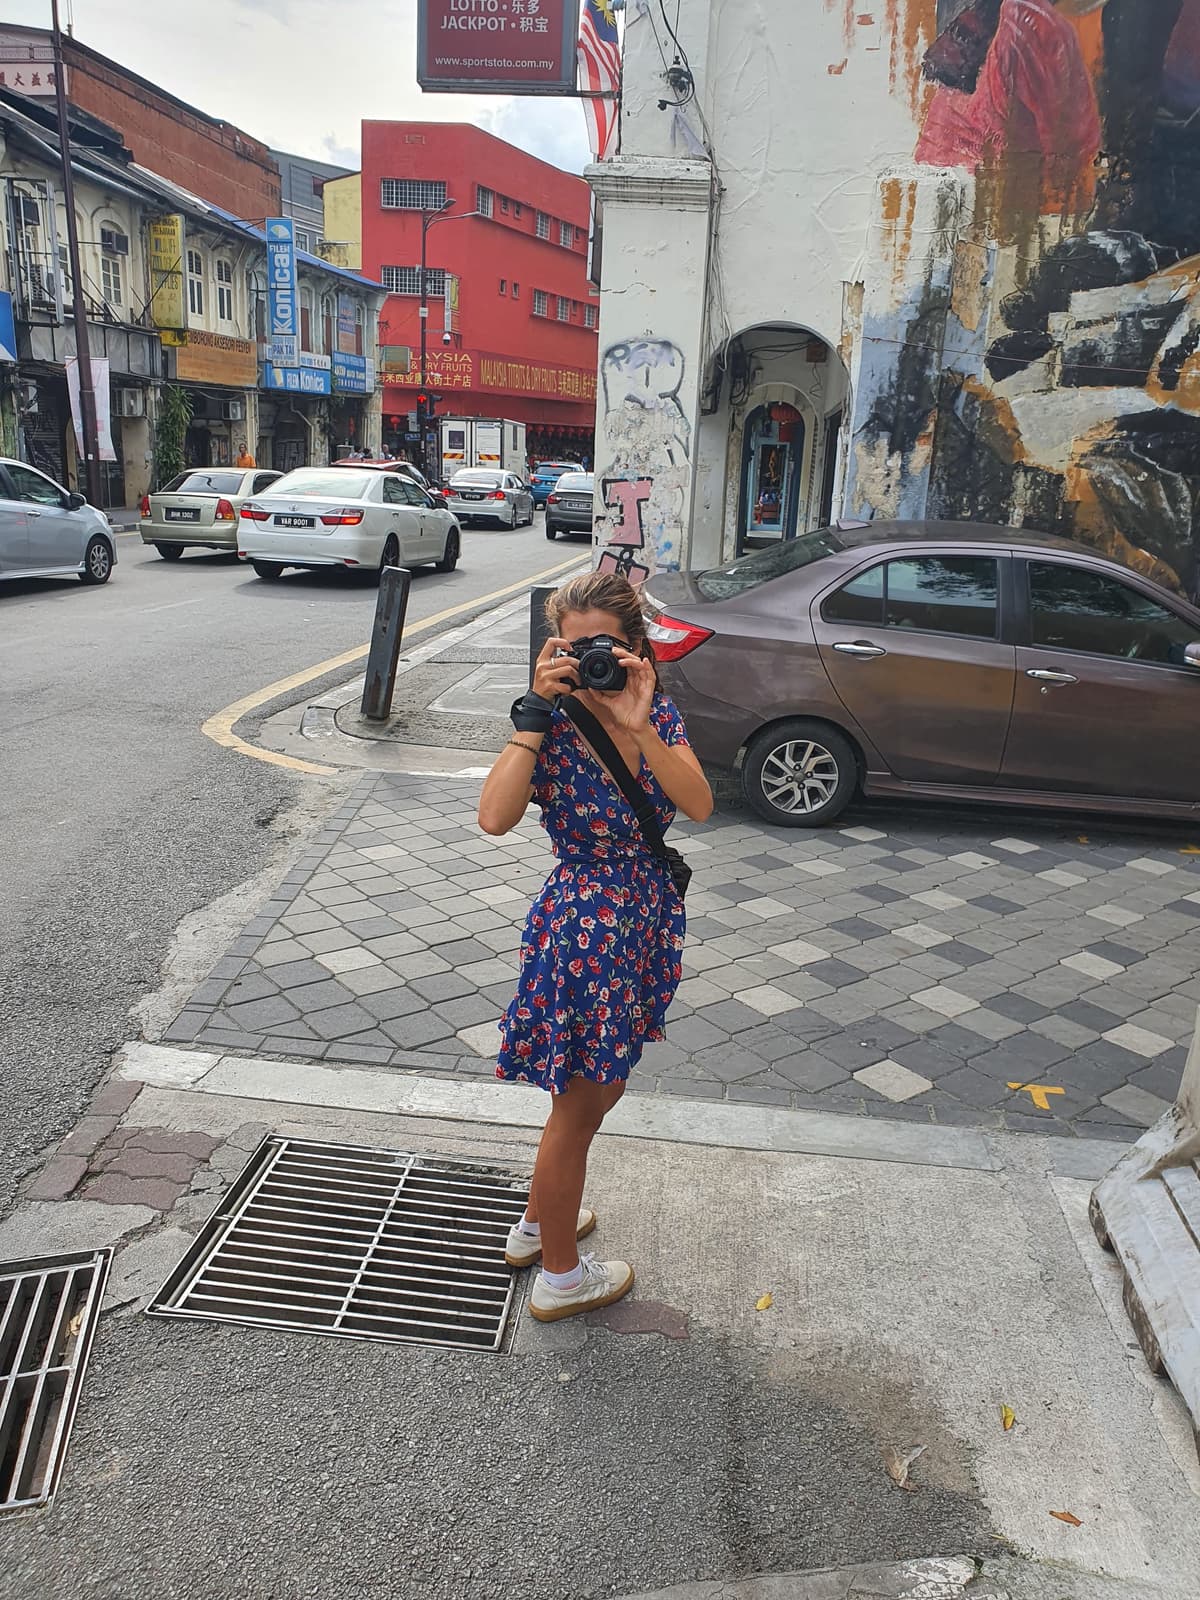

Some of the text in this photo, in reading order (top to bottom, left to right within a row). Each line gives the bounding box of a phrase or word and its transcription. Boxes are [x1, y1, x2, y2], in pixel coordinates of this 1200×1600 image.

[450, 0, 499, 12] LOTTO
[440, 16, 549, 33] JACKPOT 积宝
[435, 56, 554, 70] www.sportstoto.com.my
[272, 253, 293, 334] Konica
[410, 351, 472, 362] LAYSIA
[411, 361, 472, 372] & RY FRUITS
[480, 359, 506, 388] MALAYSIA
[300, 370, 325, 392] Konica
[293, 518, 308, 526] 9001
